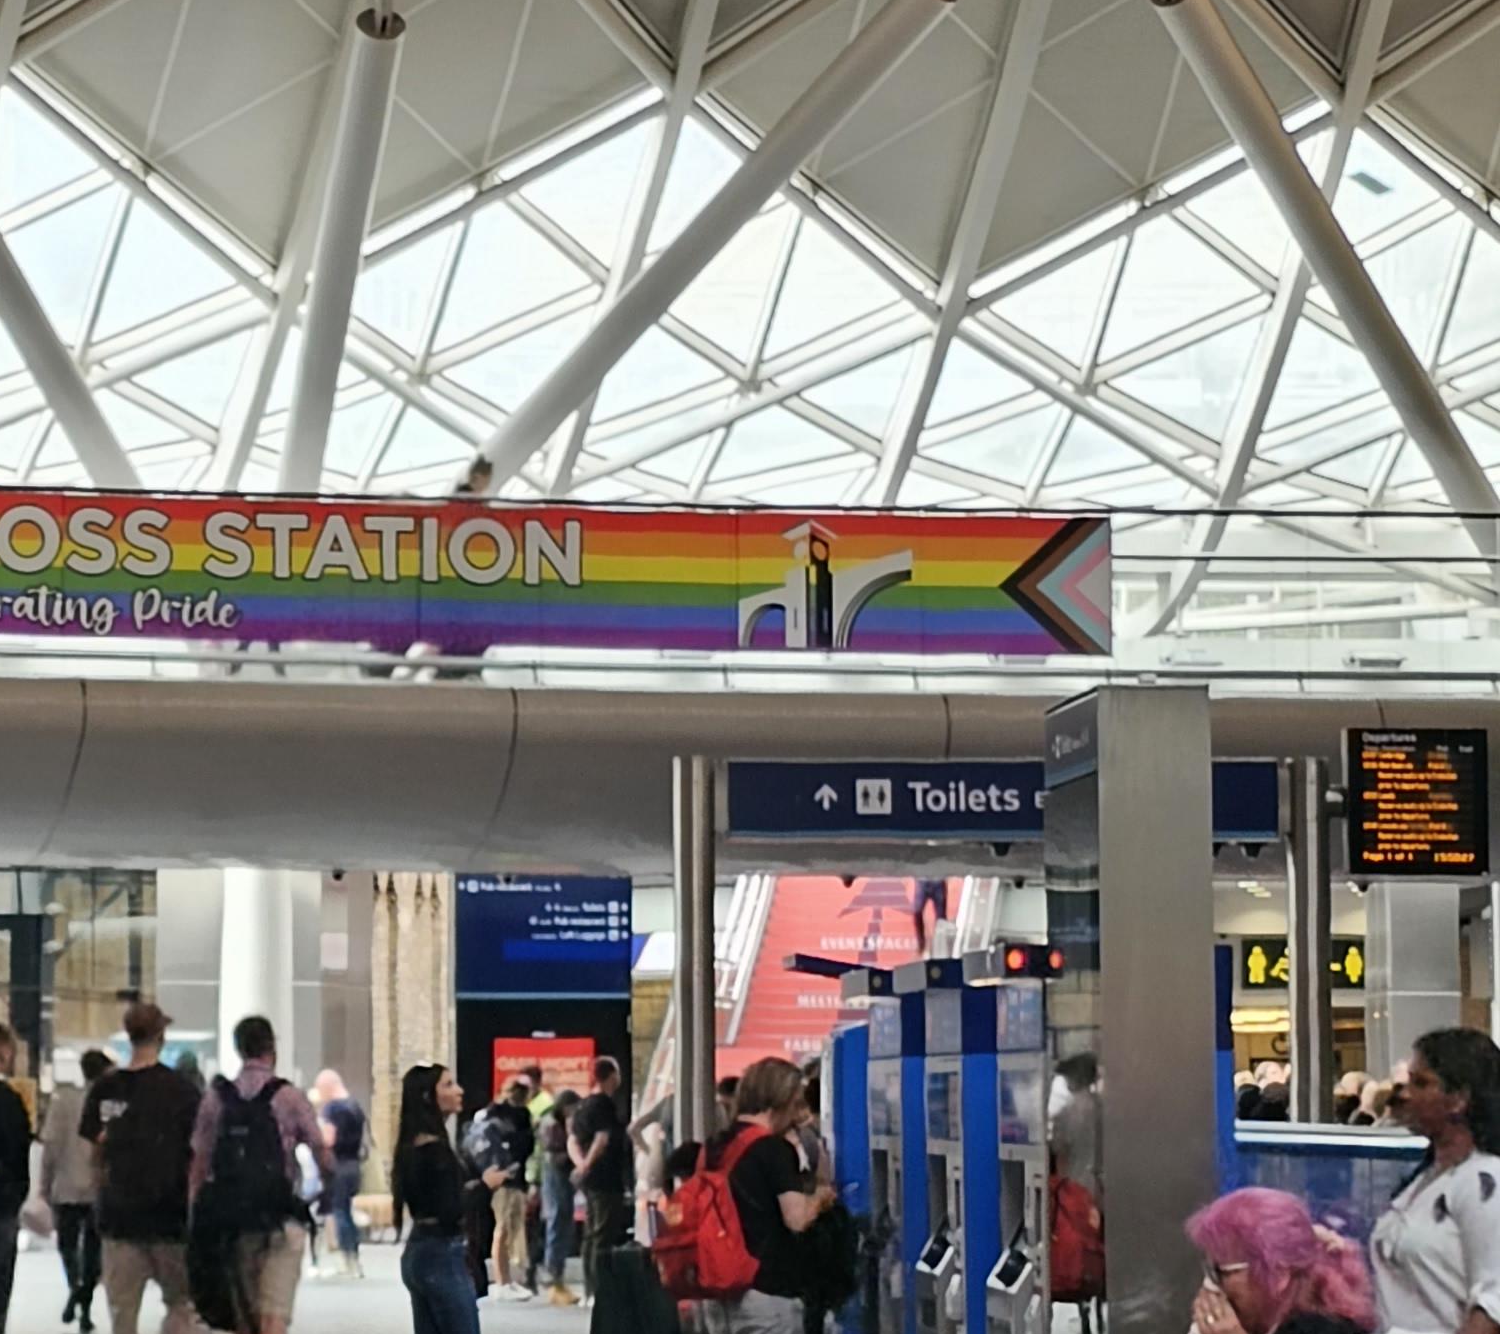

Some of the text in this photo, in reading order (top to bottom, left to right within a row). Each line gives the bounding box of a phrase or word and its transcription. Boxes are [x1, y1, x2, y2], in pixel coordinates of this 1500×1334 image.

[203, 512, 584, 587] STATION
[131, 588, 242, 631] Pride
[907, 780, 1020, 812] Toilets
